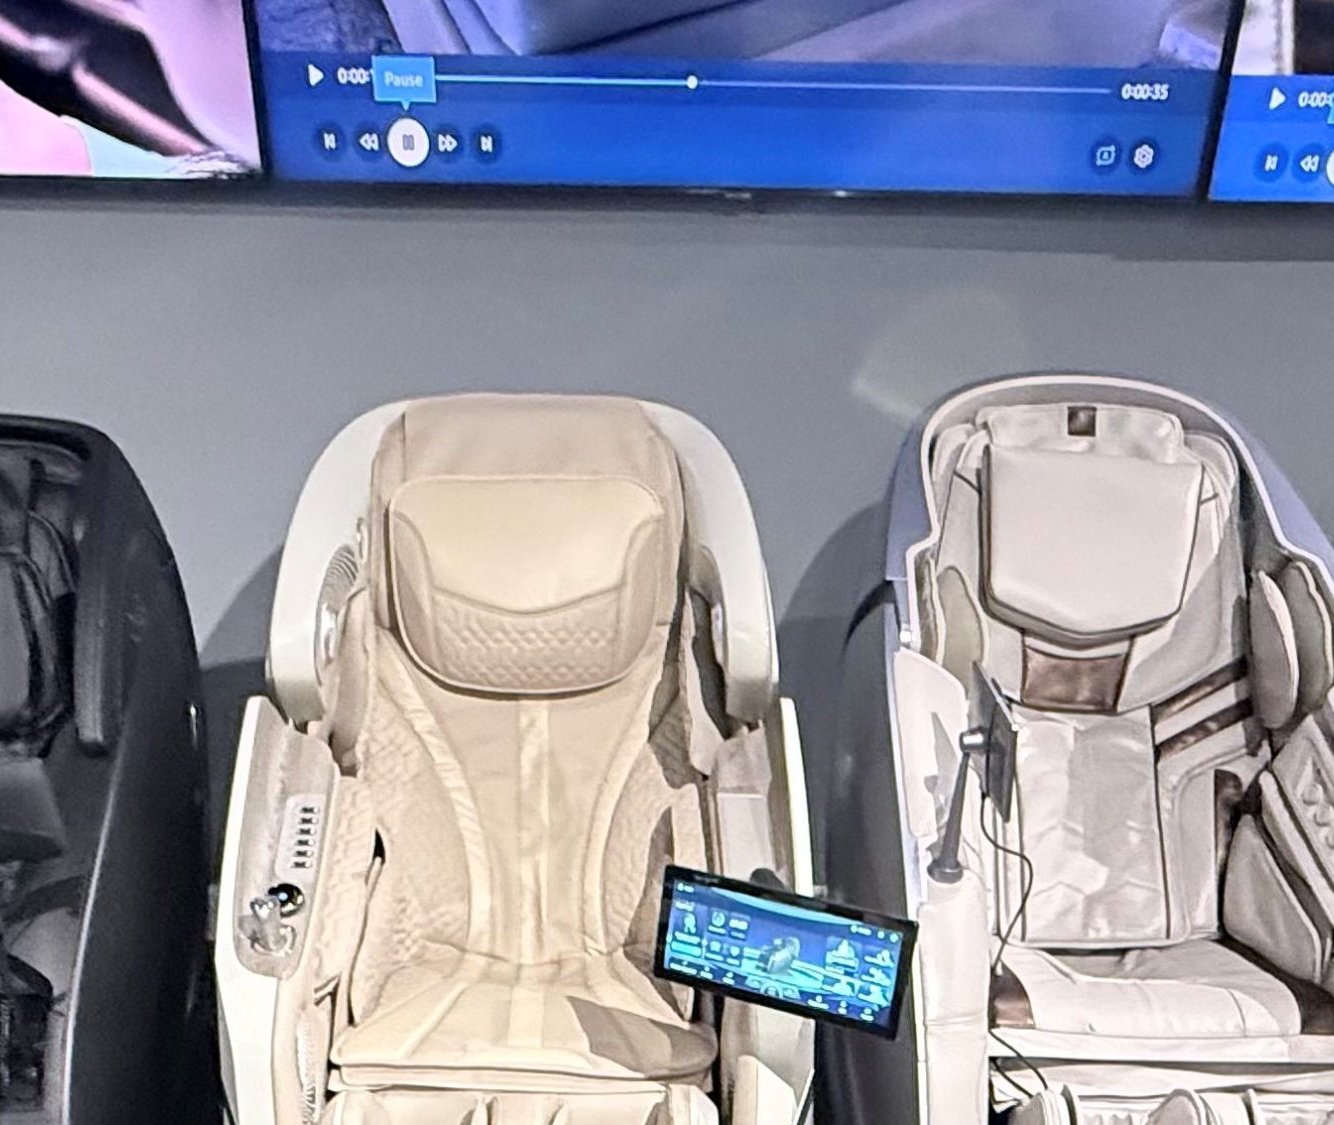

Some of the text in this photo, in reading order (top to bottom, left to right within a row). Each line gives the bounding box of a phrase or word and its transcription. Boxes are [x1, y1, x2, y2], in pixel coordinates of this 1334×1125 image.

[337, 67, 373, 84] 0:00:
[384, 71, 423, 87] Pause
[1122, 83, 1169, 99] 0:00:35
